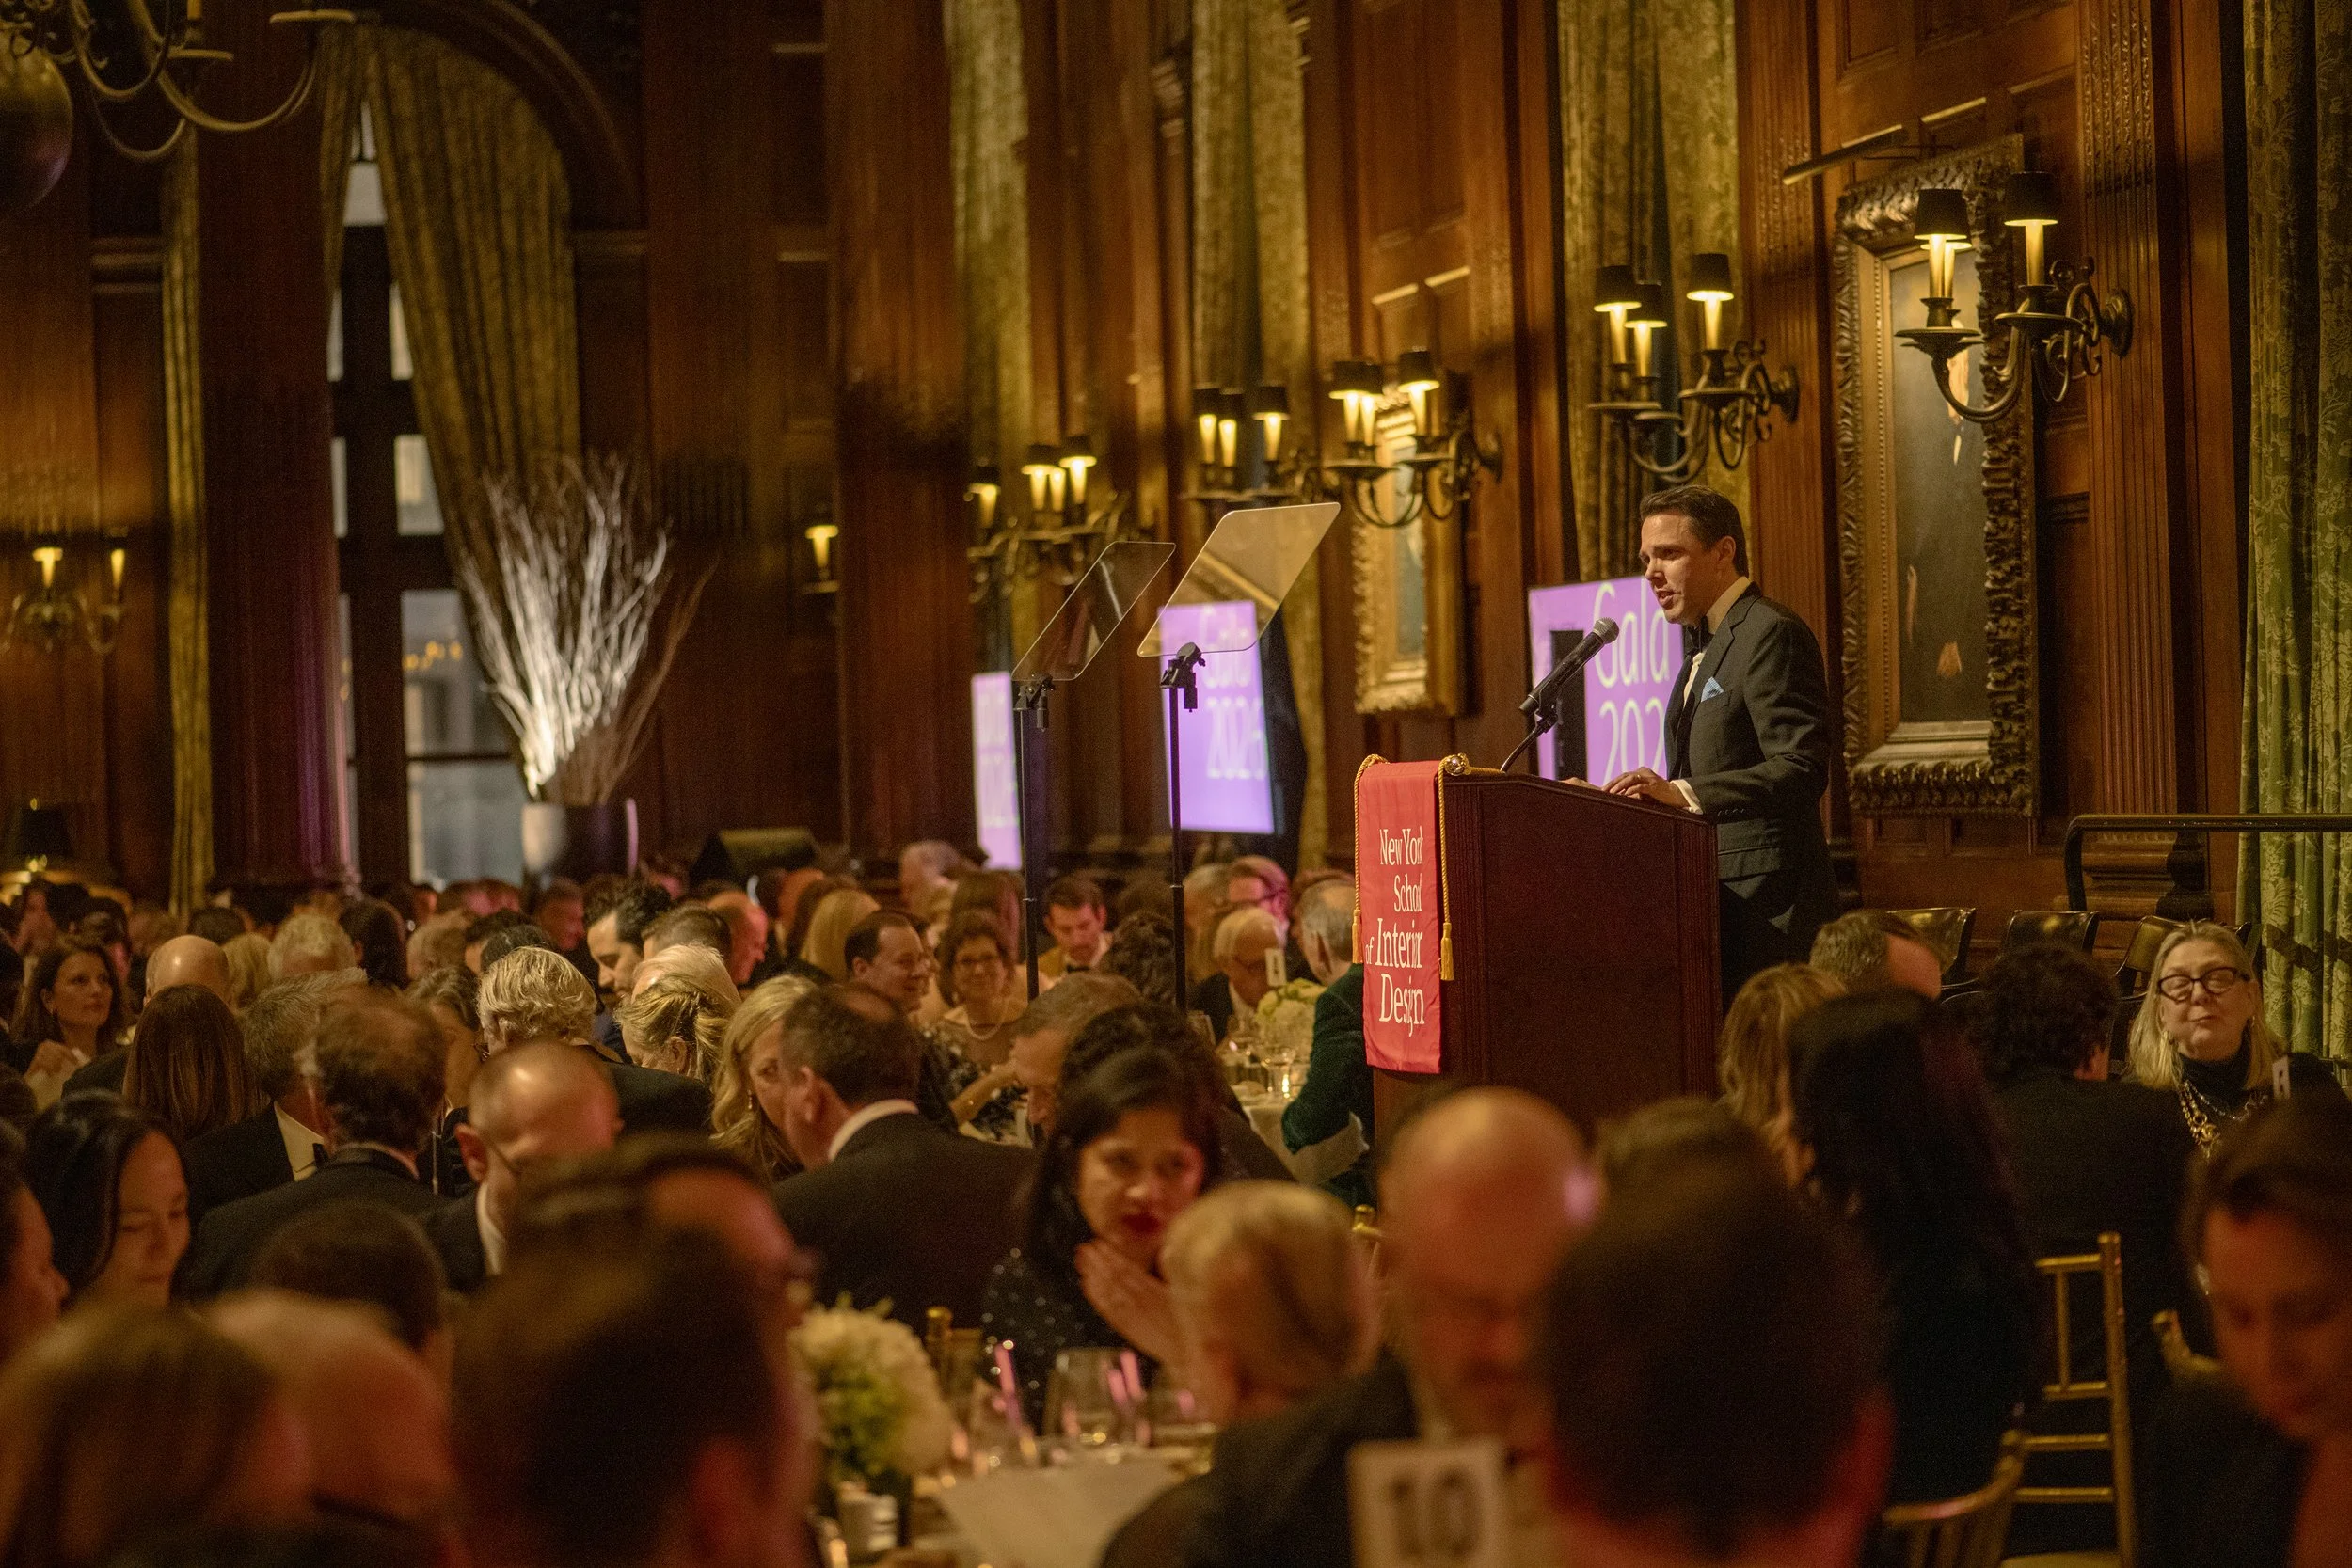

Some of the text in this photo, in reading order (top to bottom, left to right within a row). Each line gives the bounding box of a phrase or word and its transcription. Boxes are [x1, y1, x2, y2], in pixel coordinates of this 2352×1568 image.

[1594, 576, 1670, 689] Gala
[1599, 696, 1666, 786] 202
[1379, 828, 1402, 865] New
[1394, 873, 1422, 912] Schol
[1366, 917, 1423, 969] of Interir
